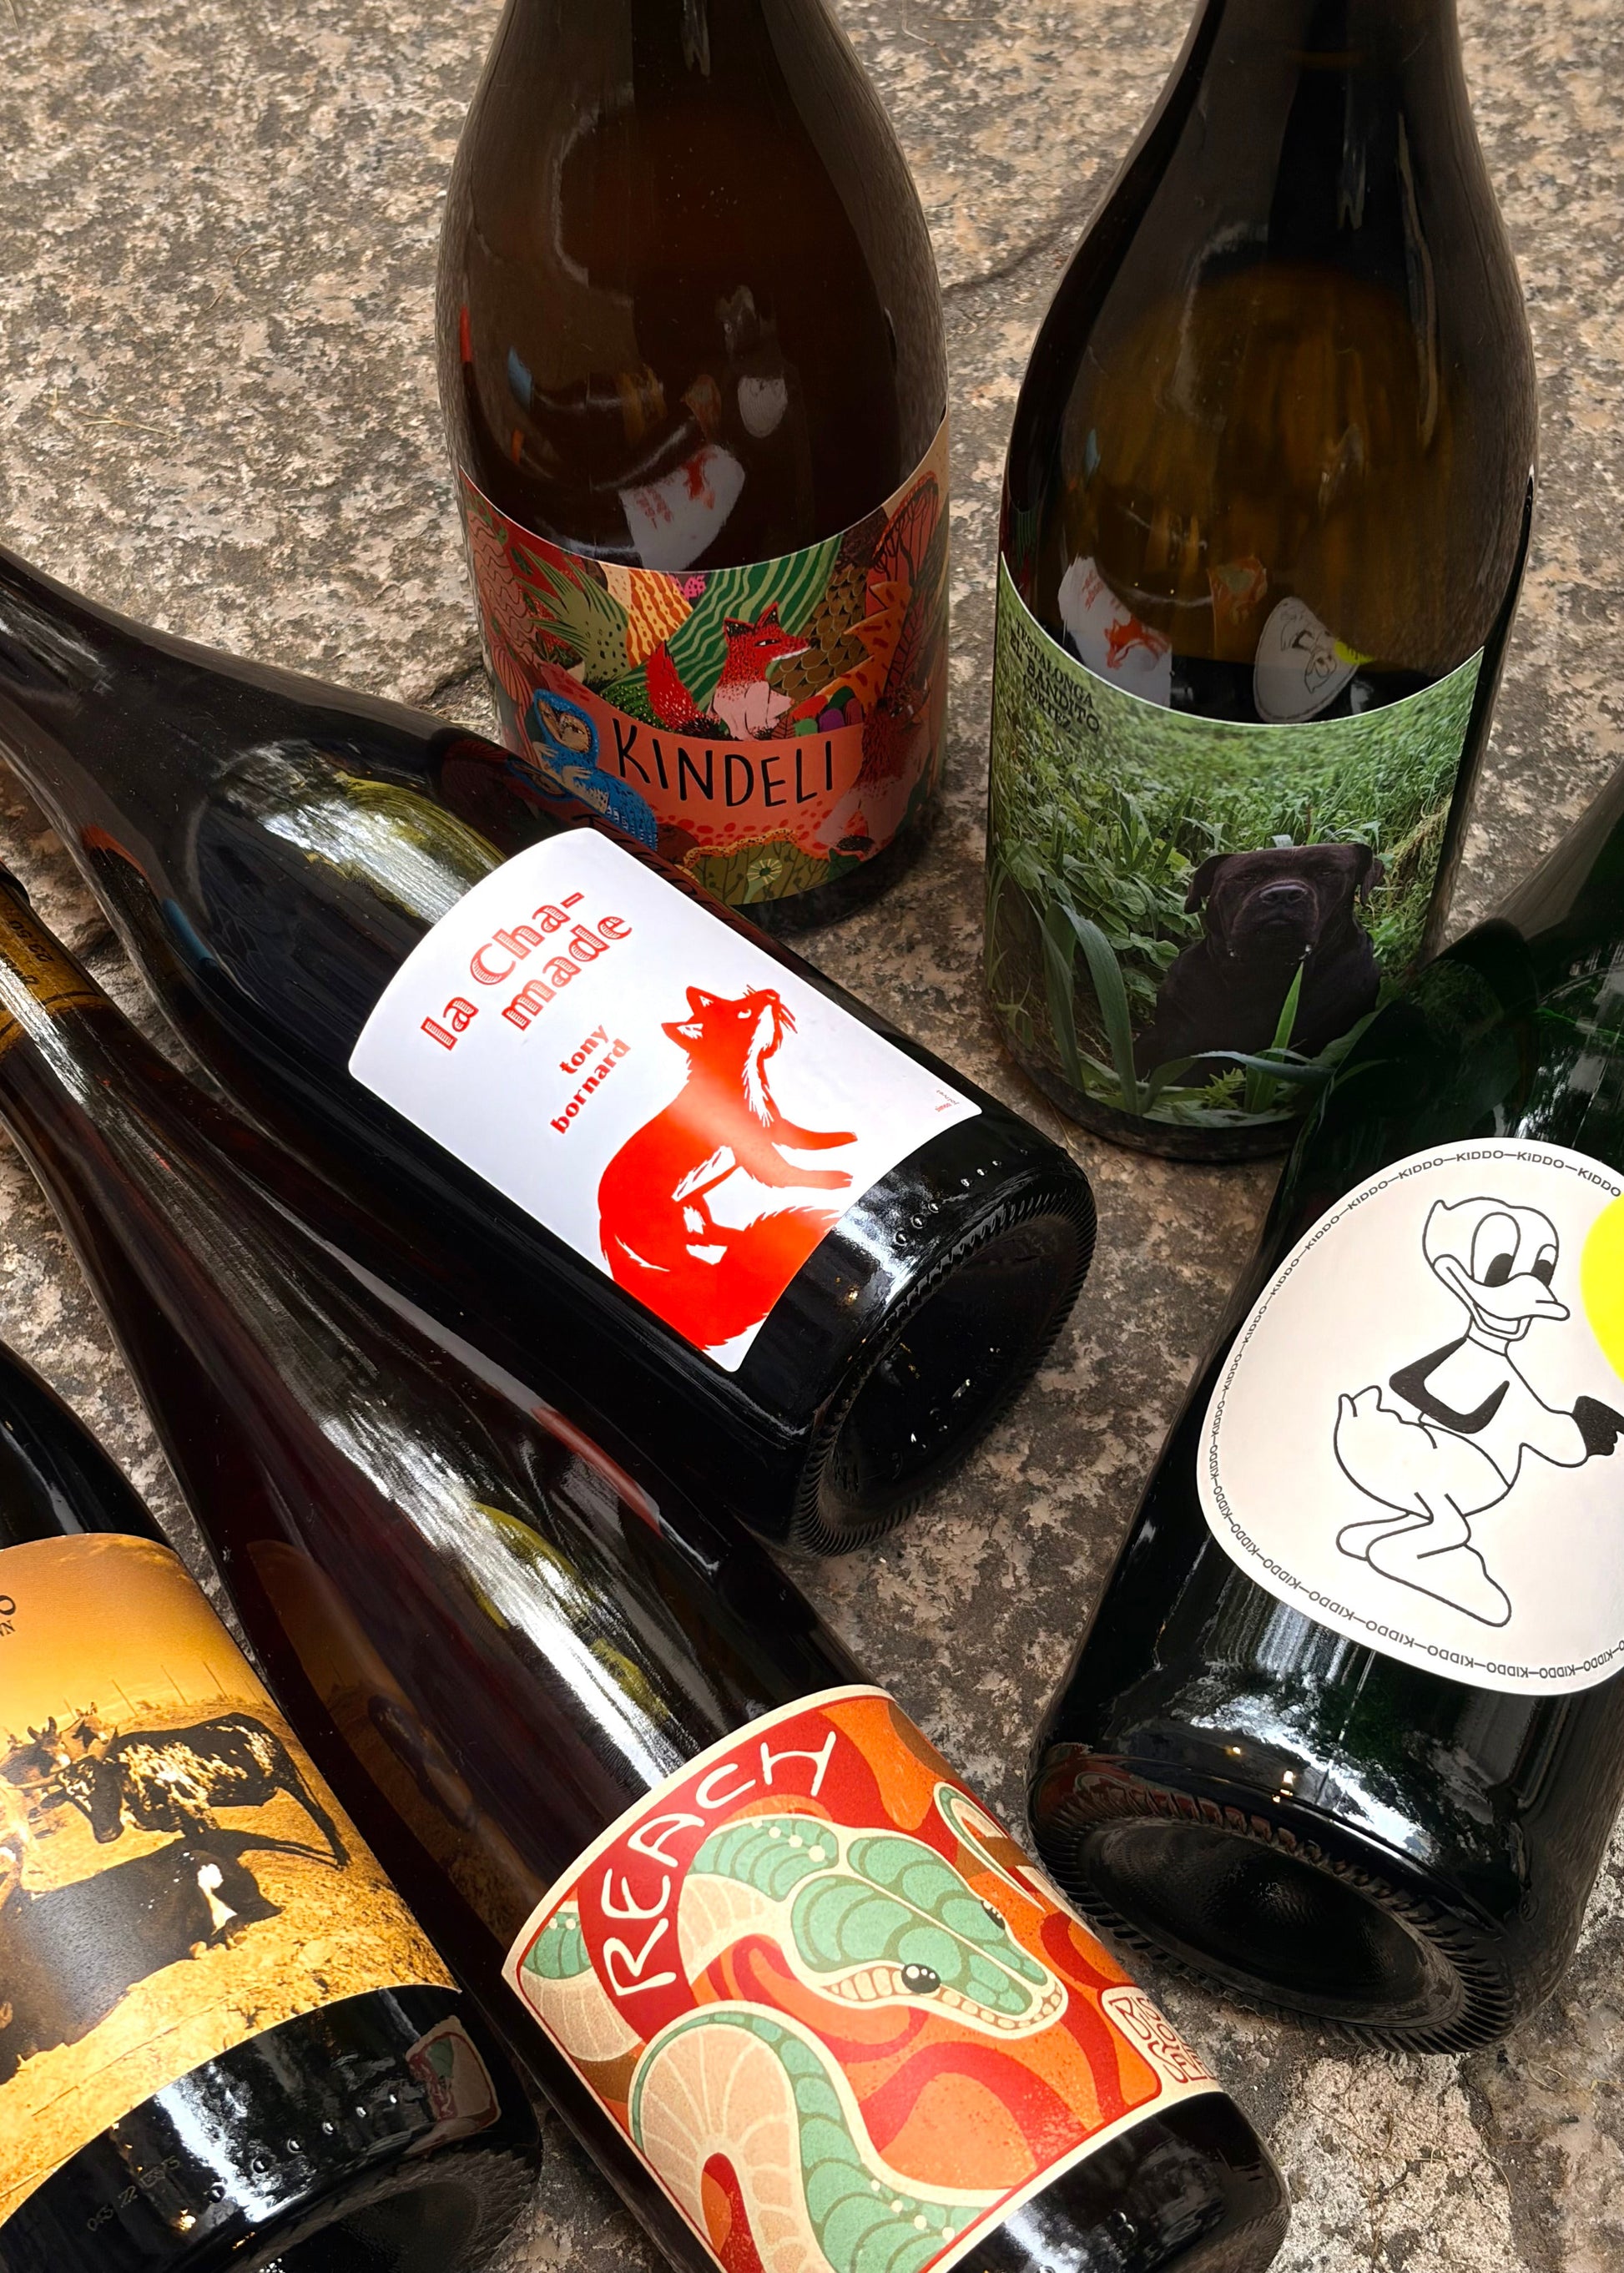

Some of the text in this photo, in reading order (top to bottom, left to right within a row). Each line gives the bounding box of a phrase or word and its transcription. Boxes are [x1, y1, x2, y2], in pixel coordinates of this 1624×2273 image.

[1010, 627, 1100, 733] EL BANDITO
[1015, 618, 1094, 709] TESTALONGA
[1023, 674, 1072, 733] CORTEZ
[612, 718, 833, 808] KINDELI
[420, 891, 585, 1051] la Cha-
[501, 915, 633, 1031] made
[549, 1038, 631, 1134] bornard
[558, 1025, 609, 1075] tony
[1209, 1150, 1621, 1679] KIDDO KIDDO KIDDO KIDDO KIDDO KIDDO KIDDO KIDDO KIDDO KIDDO KIDDO KIDDO KIDDO KIDDO KIDDO KIDDO KIDDO KIDDO KIDDO KIDDO
[600, 1731, 837, 1997] REACH
